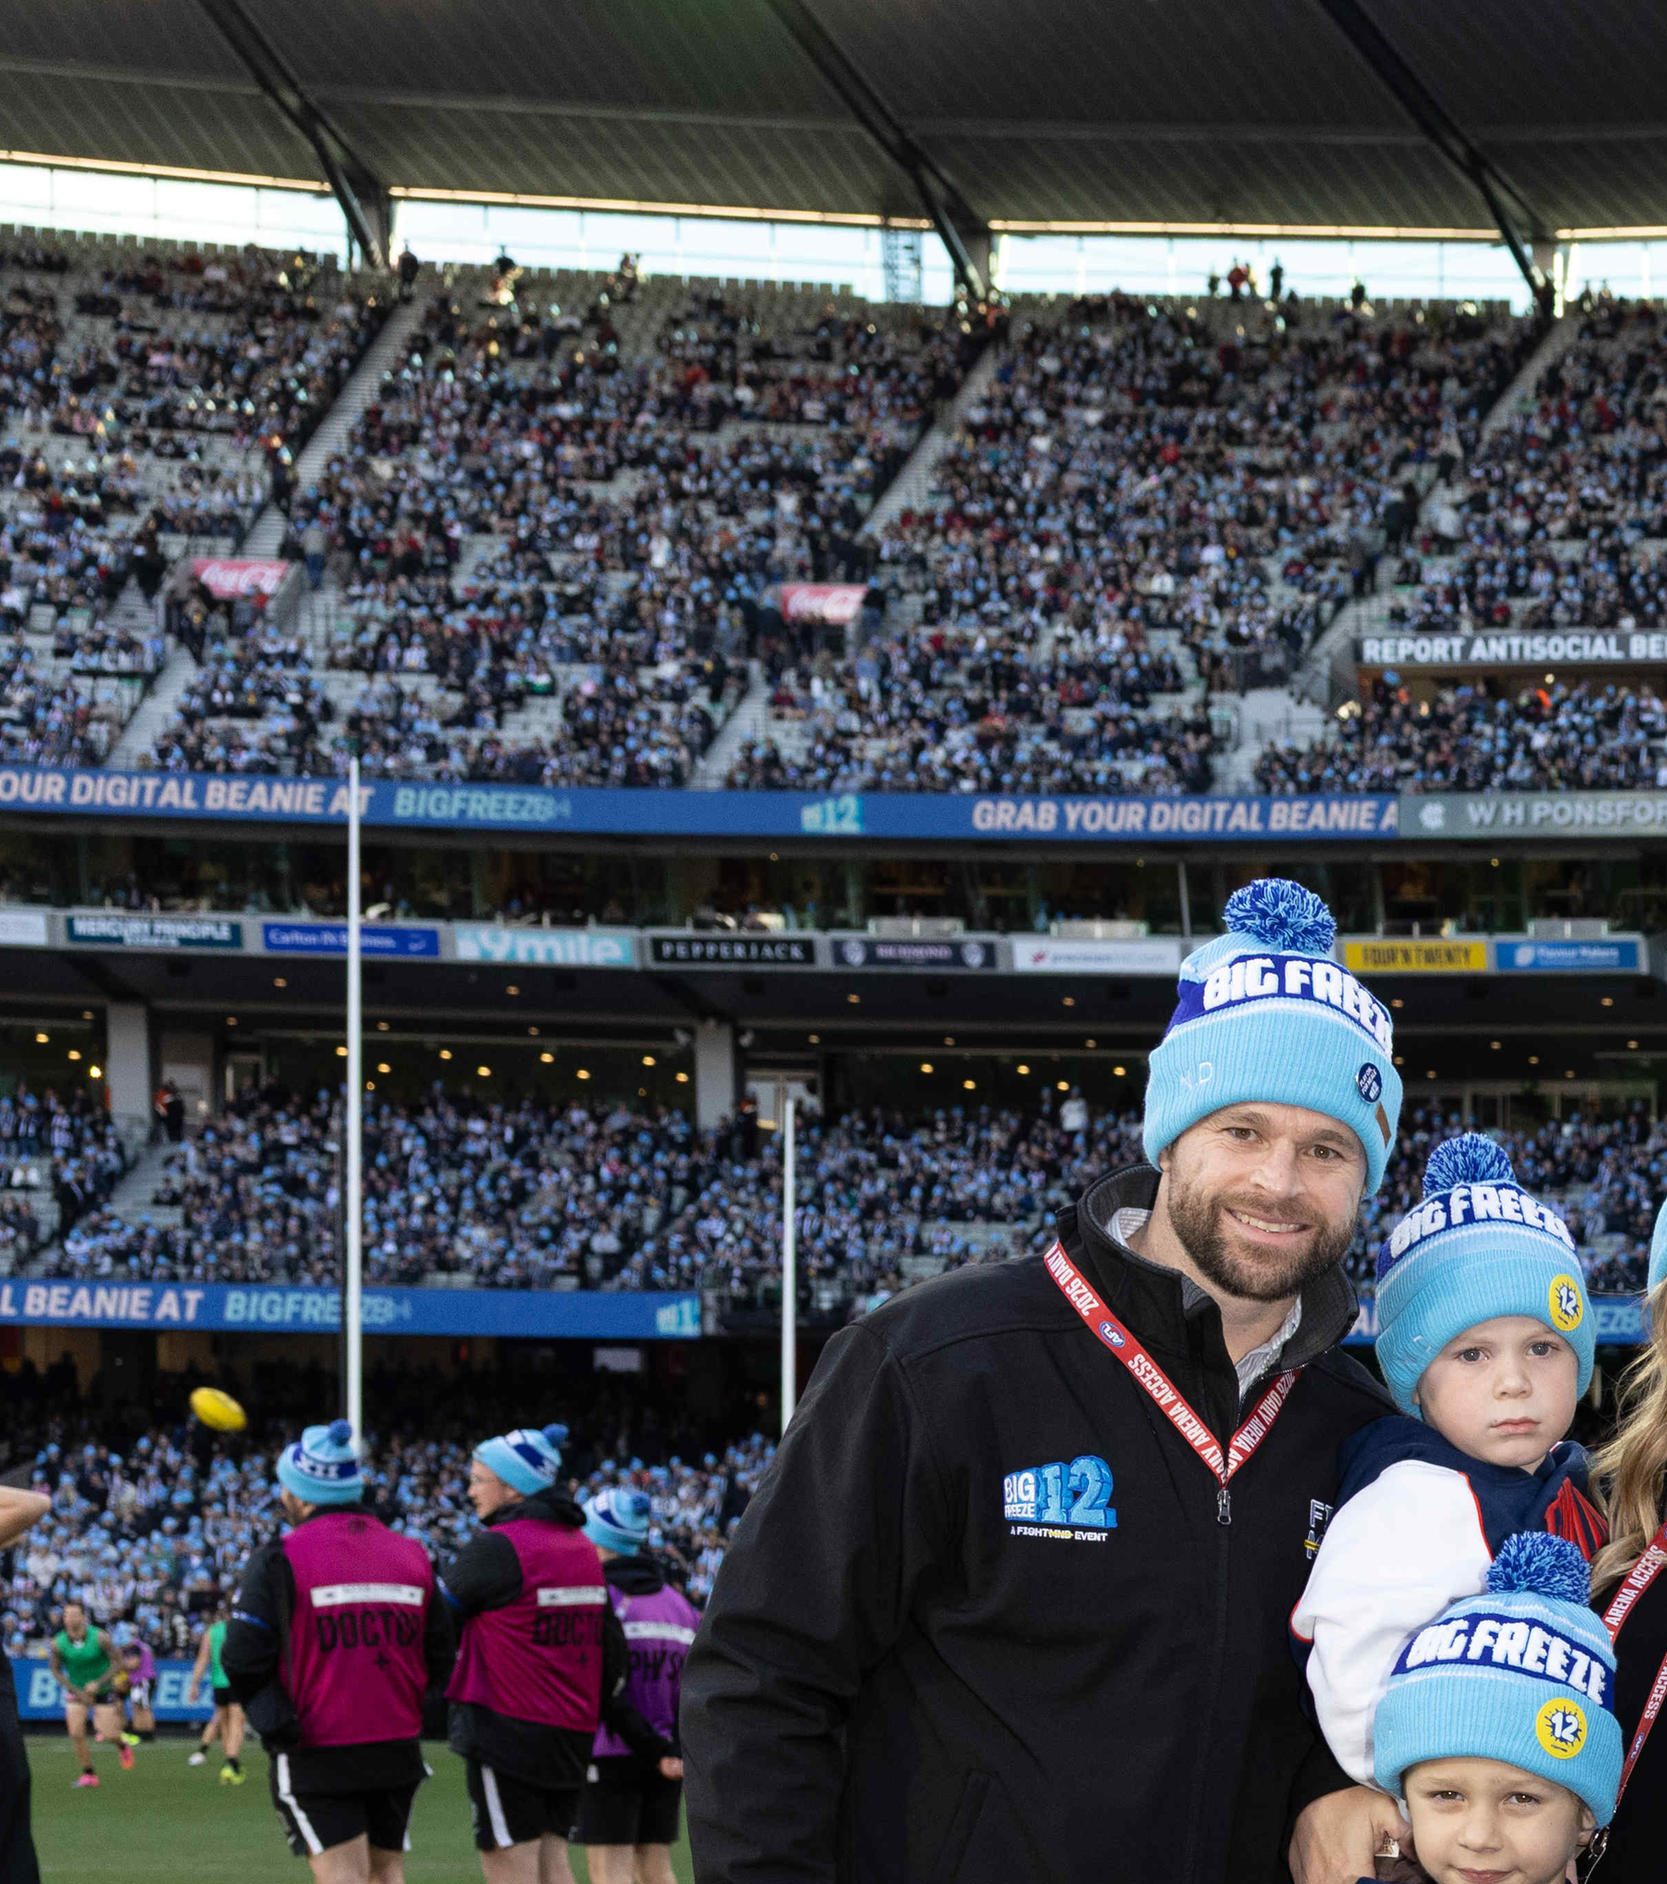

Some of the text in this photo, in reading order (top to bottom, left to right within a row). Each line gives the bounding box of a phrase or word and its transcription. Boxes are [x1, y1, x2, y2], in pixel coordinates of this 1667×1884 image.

[1362, 638, 1467, 663] REPORT
[1470, 636, 1621, 662] ANTISOCIAL
[0, 772, 65, 807] OUR
[71, 776, 198, 810] DIGITAL
[205, 780, 325, 814] BEANIE
[329, 785, 376, 816] AT
[972, 799, 1398, 833] GRAB YOUR DIGITAL BEANIE A
[660, 939, 806, 960] PEPPERJACK
[1203, 958, 1279, 1011] BIG
[23, 1284, 151, 1321] BEANIE
[154, 1288, 204, 1321] AT
[1065, 1273, 1099, 1317] 2026
[1560, 1286, 1577, 1317] 12
[1127, 1353, 1177, 1405] ACCESS
[1168, 1401, 1212, 1447] ARENA
[1257, 1391, 1282, 1425] DAILY
[1233, 1415, 1268, 1453] ARENA
[1004, 1472, 1036, 1503] BIG
[1040, 1457, 1114, 1526] 12
[1004, 1503, 1036, 1519] FREEZE
[1075, 1531, 1109, 1543] EVENT
[1606, 1587, 1639, 1626] ARENA
[1467, 1619, 1606, 1705] FREEZE
[1552, 1712, 1580, 1743] 12
